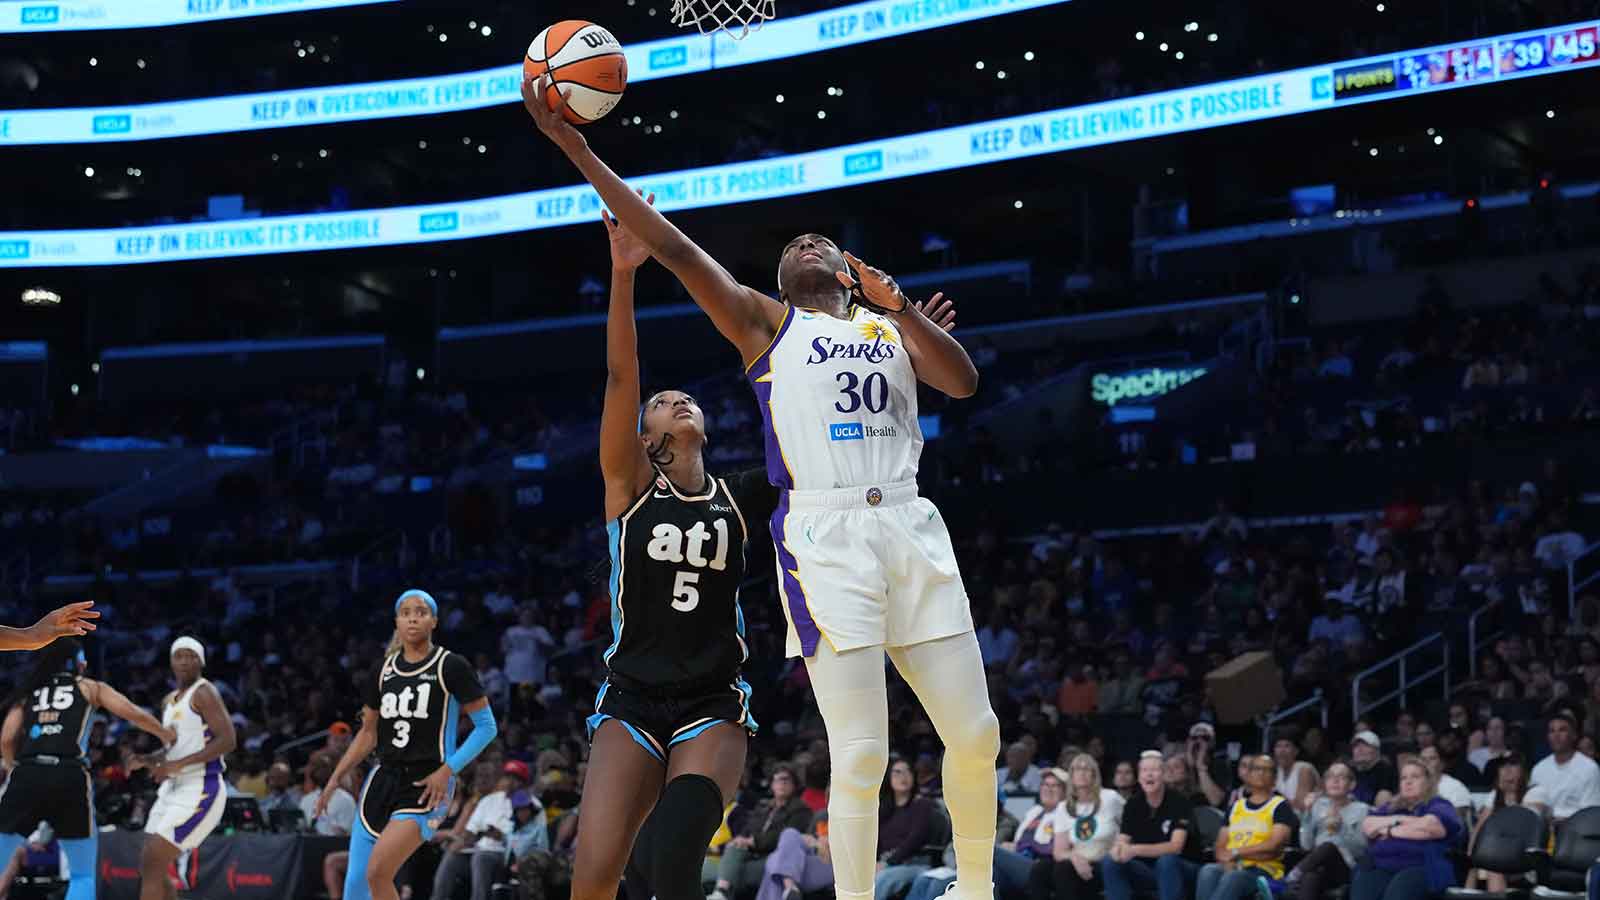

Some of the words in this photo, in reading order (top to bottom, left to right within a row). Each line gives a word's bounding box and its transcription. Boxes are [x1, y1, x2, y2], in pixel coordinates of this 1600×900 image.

[818, 12, 858, 40] KEEP
[863, 6, 887, 30] ON
[1514, 41, 1544, 67] 39
[252, 100, 291, 120] KEEP
[296, 98, 317, 115] ON
[322, 86, 428, 115] OVERCOMING
[434, 80, 479, 102] EVERY
[970, 129, 1014, 154] KEEP
[1020, 127, 1044, 146] ON
[1049, 109, 1145, 142] BELIEVING
[1150, 103, 1185, 126] IT'S
[1190, 83, 1283, 121] POSSIBLE
[692, 173, 724, 198] IT'S
[727, 162, 806, 195] POSSIBLE
[536, 195, 576, 218] KEEP
[579, 193, 601, 213] ON
[116, 235, 153, 254] KEEP
[159, 233, 180, 251] ON
[185, 225, 264, 250] BELIEVING
[269, 222, 298, 243] IT'S
[303, 218, 380, 242] POSSIBLE
[834, 372, 889, 414] 30
[835, 426, 861, 438] UCLA
[865, 425, 897, 438] Health
[709, 503, 733, 513] Albert
[647, 518, 729, 571] atl
[671, 571, 700, 612] 5
[32, 685, 74, 712] 15
[380, 682, 431, 719] atl
[391, 720, 411, 748] 3
